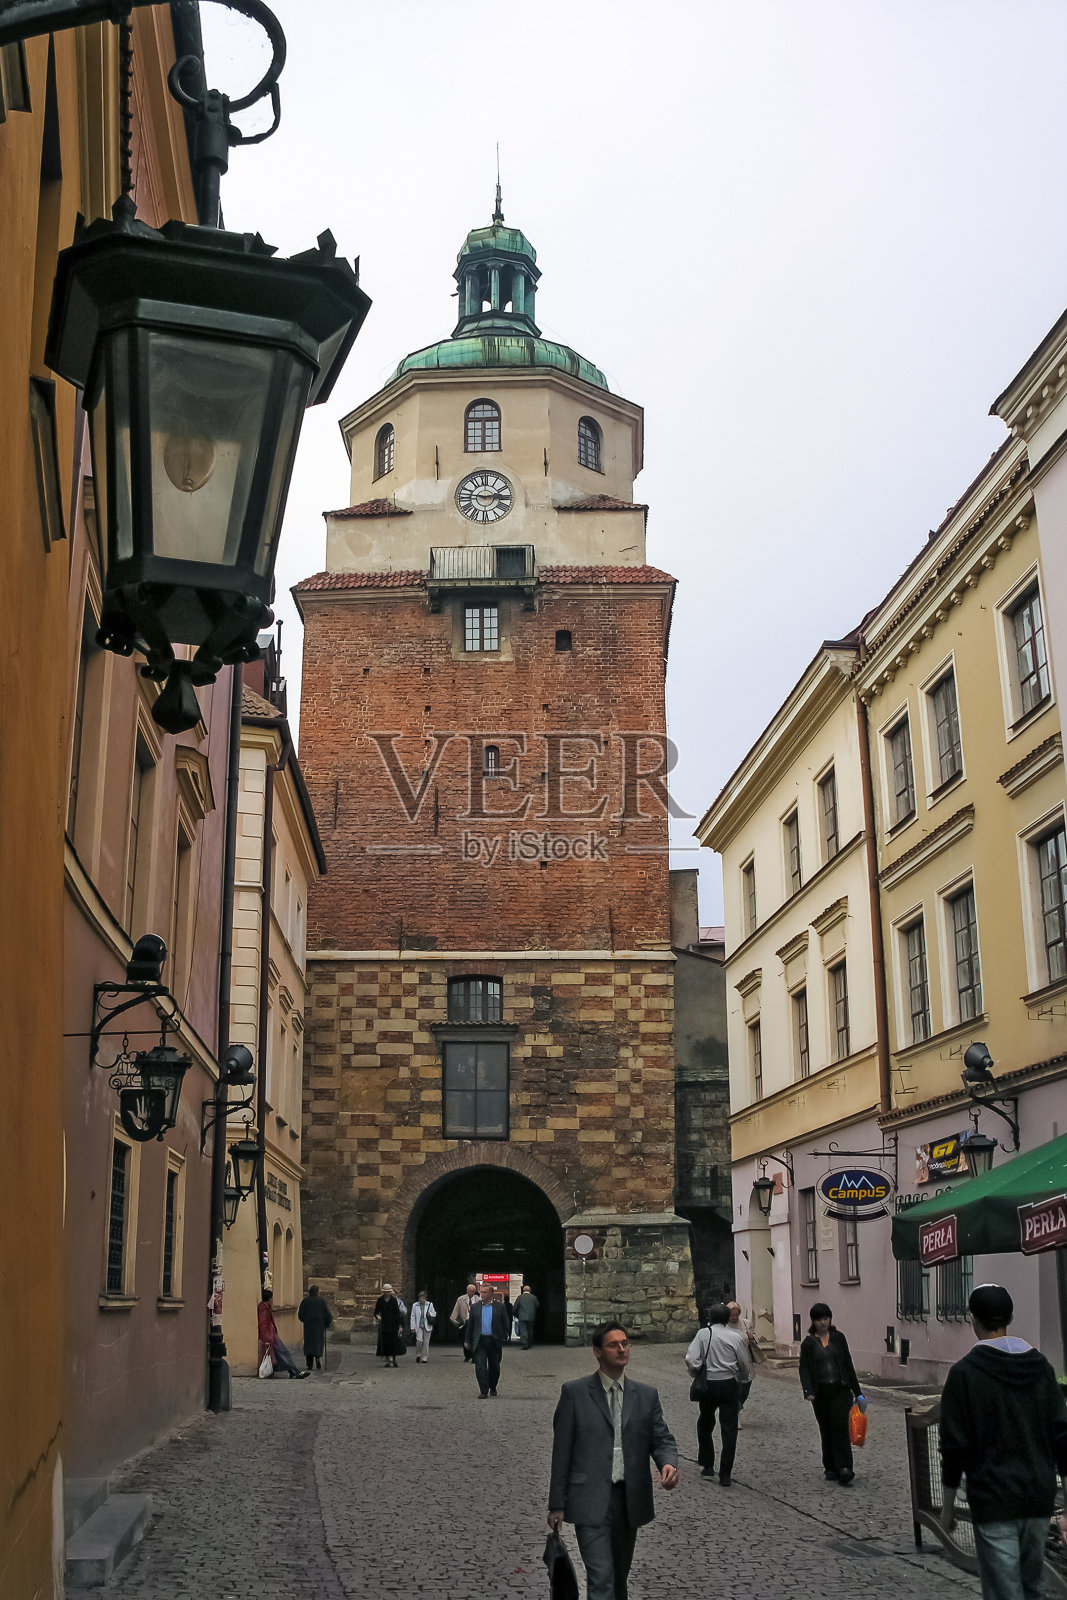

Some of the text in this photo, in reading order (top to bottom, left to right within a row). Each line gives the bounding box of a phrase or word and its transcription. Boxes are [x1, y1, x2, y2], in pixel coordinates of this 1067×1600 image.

[933, 1139, 957, 1159] GT
[1024, 1206, 1067, 1241] PERŁA
[923, 1225, 953, 1254] PERŁA
